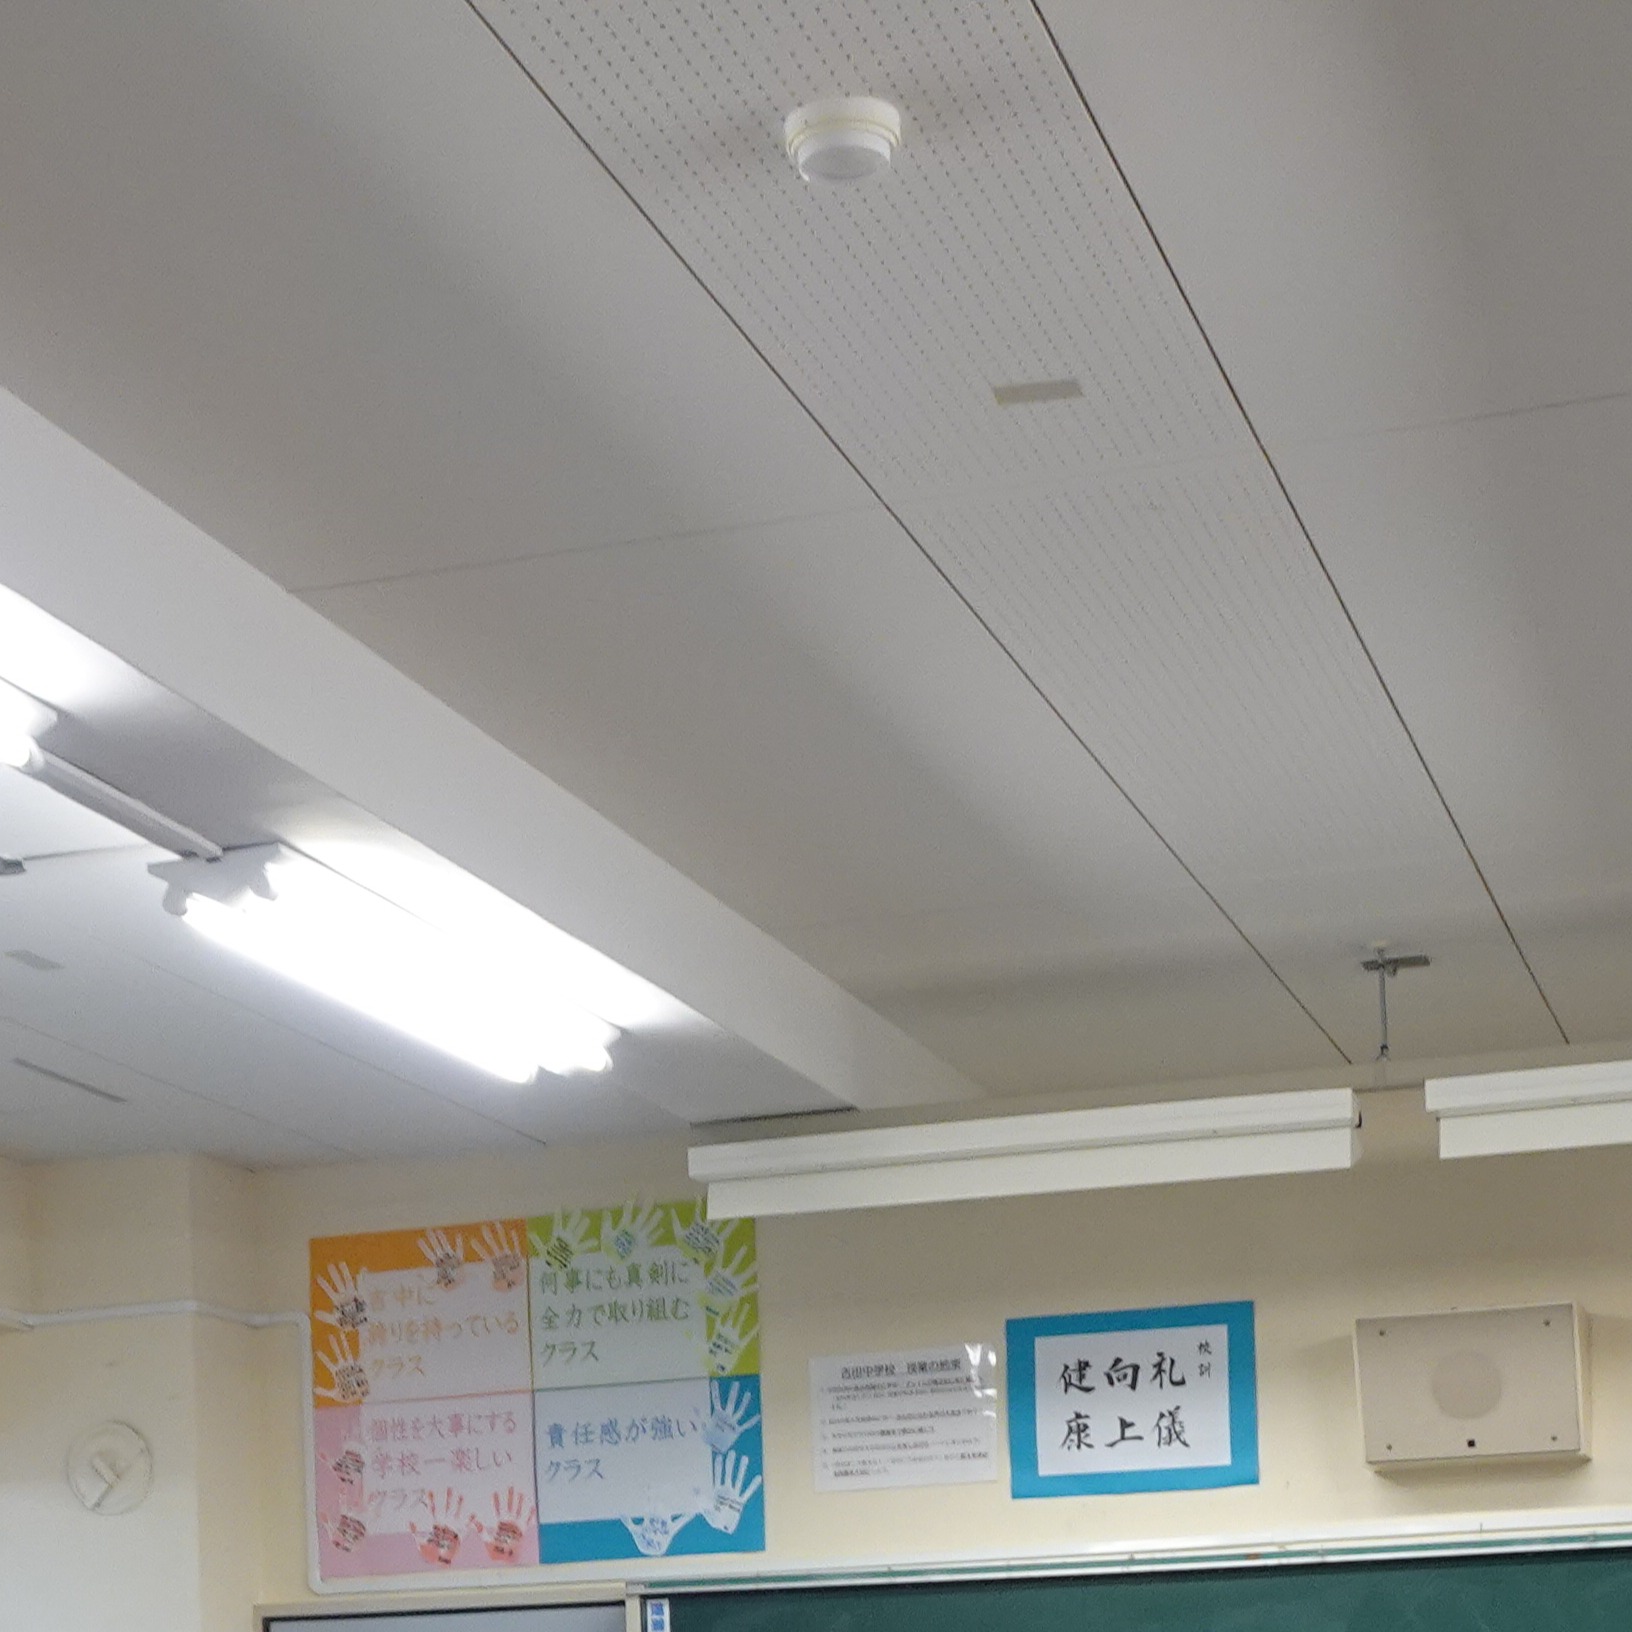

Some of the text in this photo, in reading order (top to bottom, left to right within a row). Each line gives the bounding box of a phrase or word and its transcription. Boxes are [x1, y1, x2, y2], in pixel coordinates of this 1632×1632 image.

[541, 1259, 689, 1296] 何事にも真剣に
[541, 1298, 689, 1331] 全力で取り組む
[542, 1340, 599, 1368] クラス
[1196, 1338, 1214, 1380] 校訓
[1057, 1358, 1096, 1451] 健康
[1102, 1356, 1145, 1449] 向上
[1150, 1351, 1191, 1449] 礼儀
[545, 1415, 699, 1449] 責任感が強い
[546, 1456, 605, 1482] クラス
